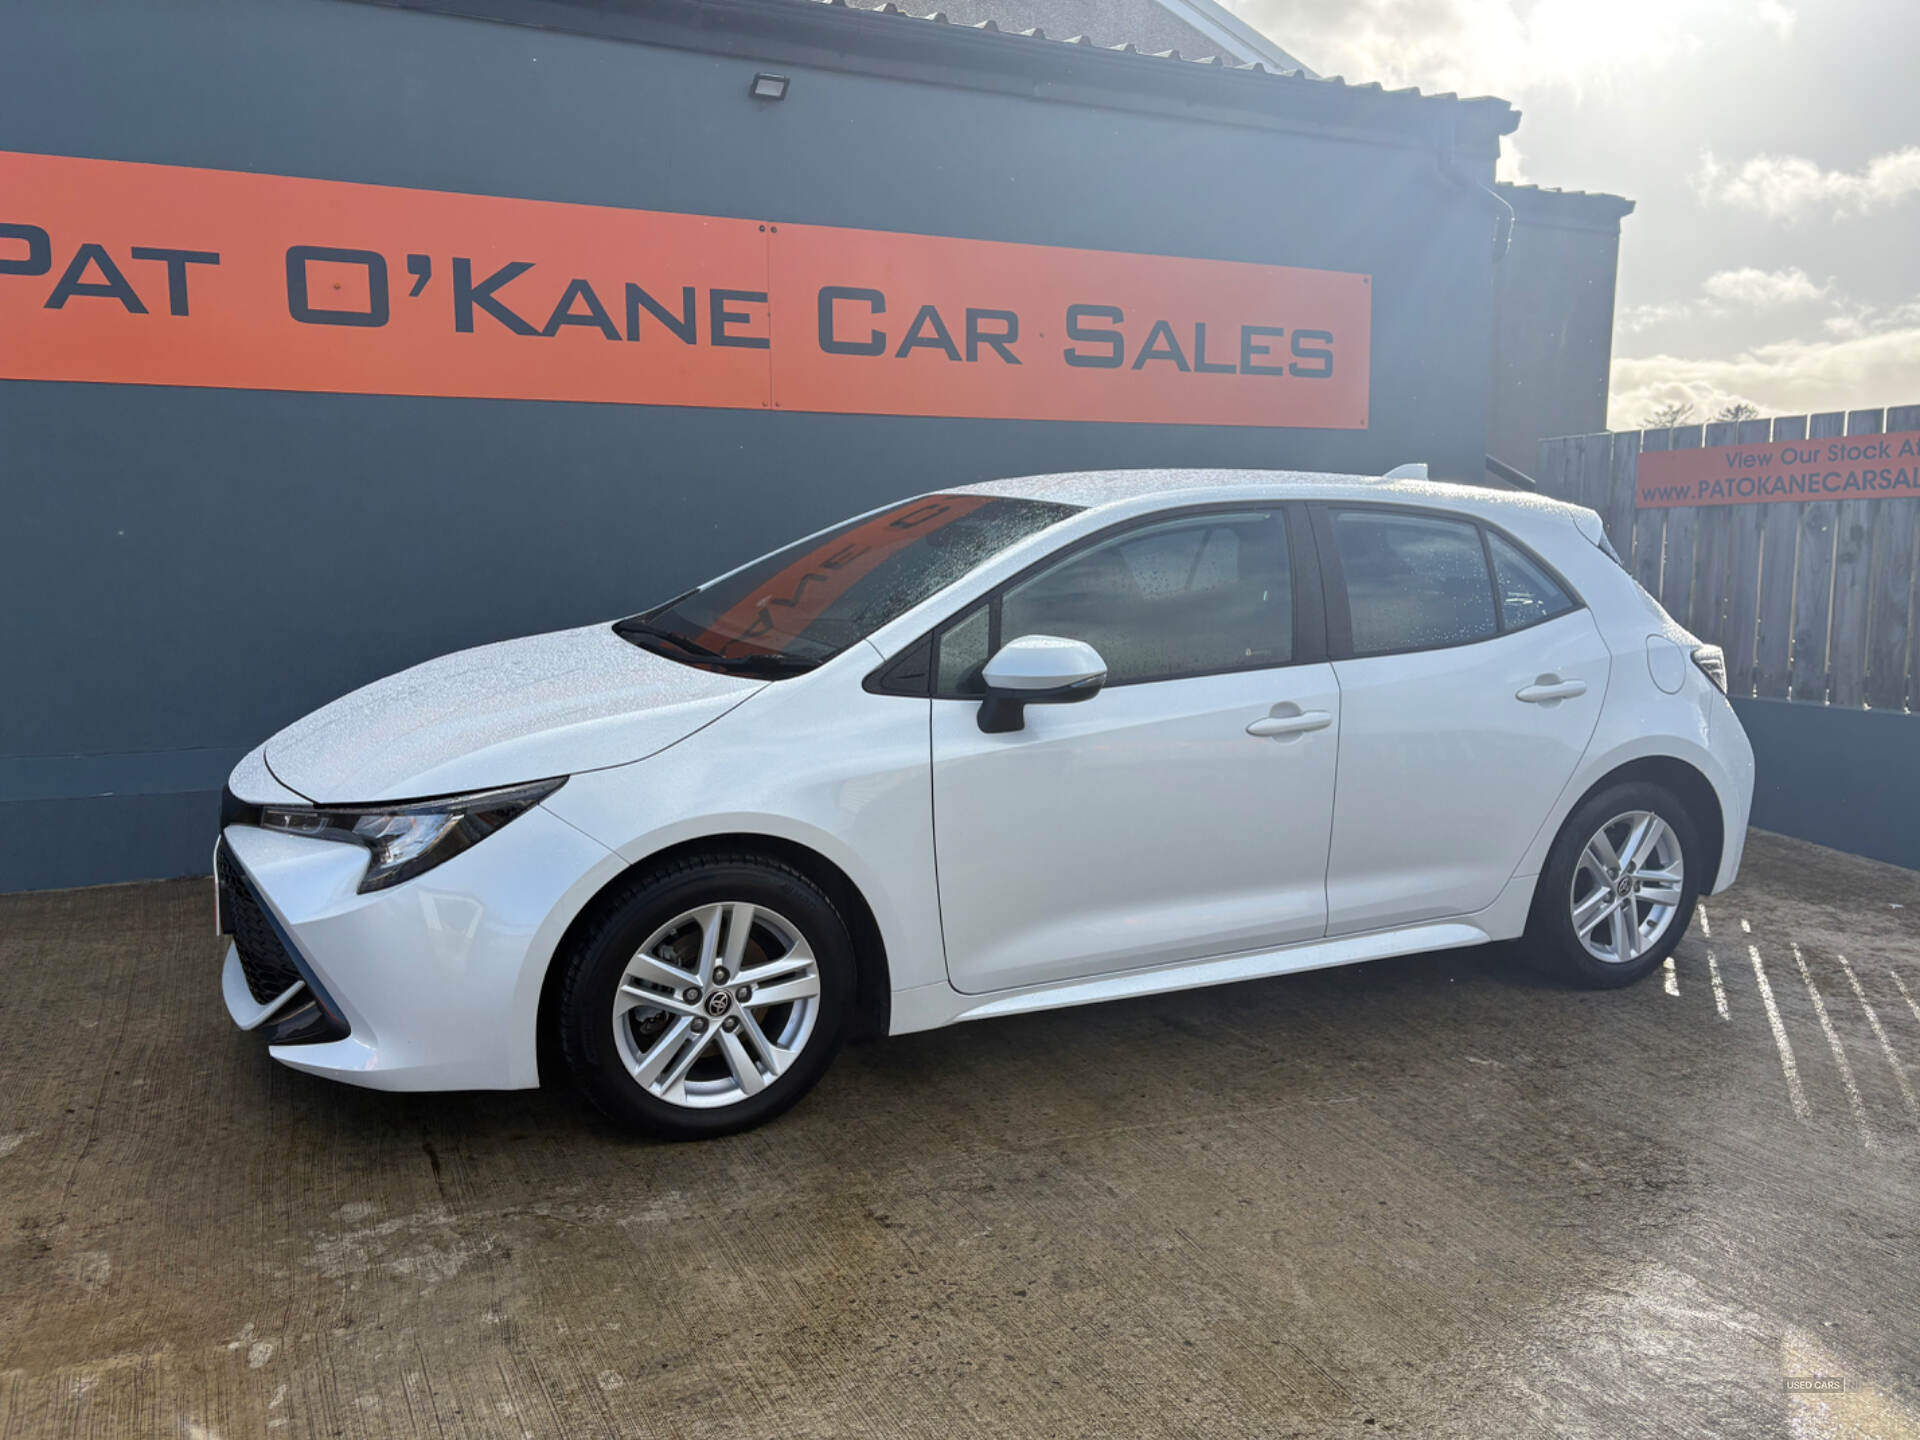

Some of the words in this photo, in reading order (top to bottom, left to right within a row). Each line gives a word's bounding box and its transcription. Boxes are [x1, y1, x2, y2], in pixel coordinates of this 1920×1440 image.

[285, 245, 770, 350] O'KANE
[817, 285, 1023, 366] CAR
[1063, 303, 1335, 380] SALES
[1725, 451, 1774, 469] View
[1781, 447, 1820, 466] Our
[1827, 439, 1892, 463] Stock
